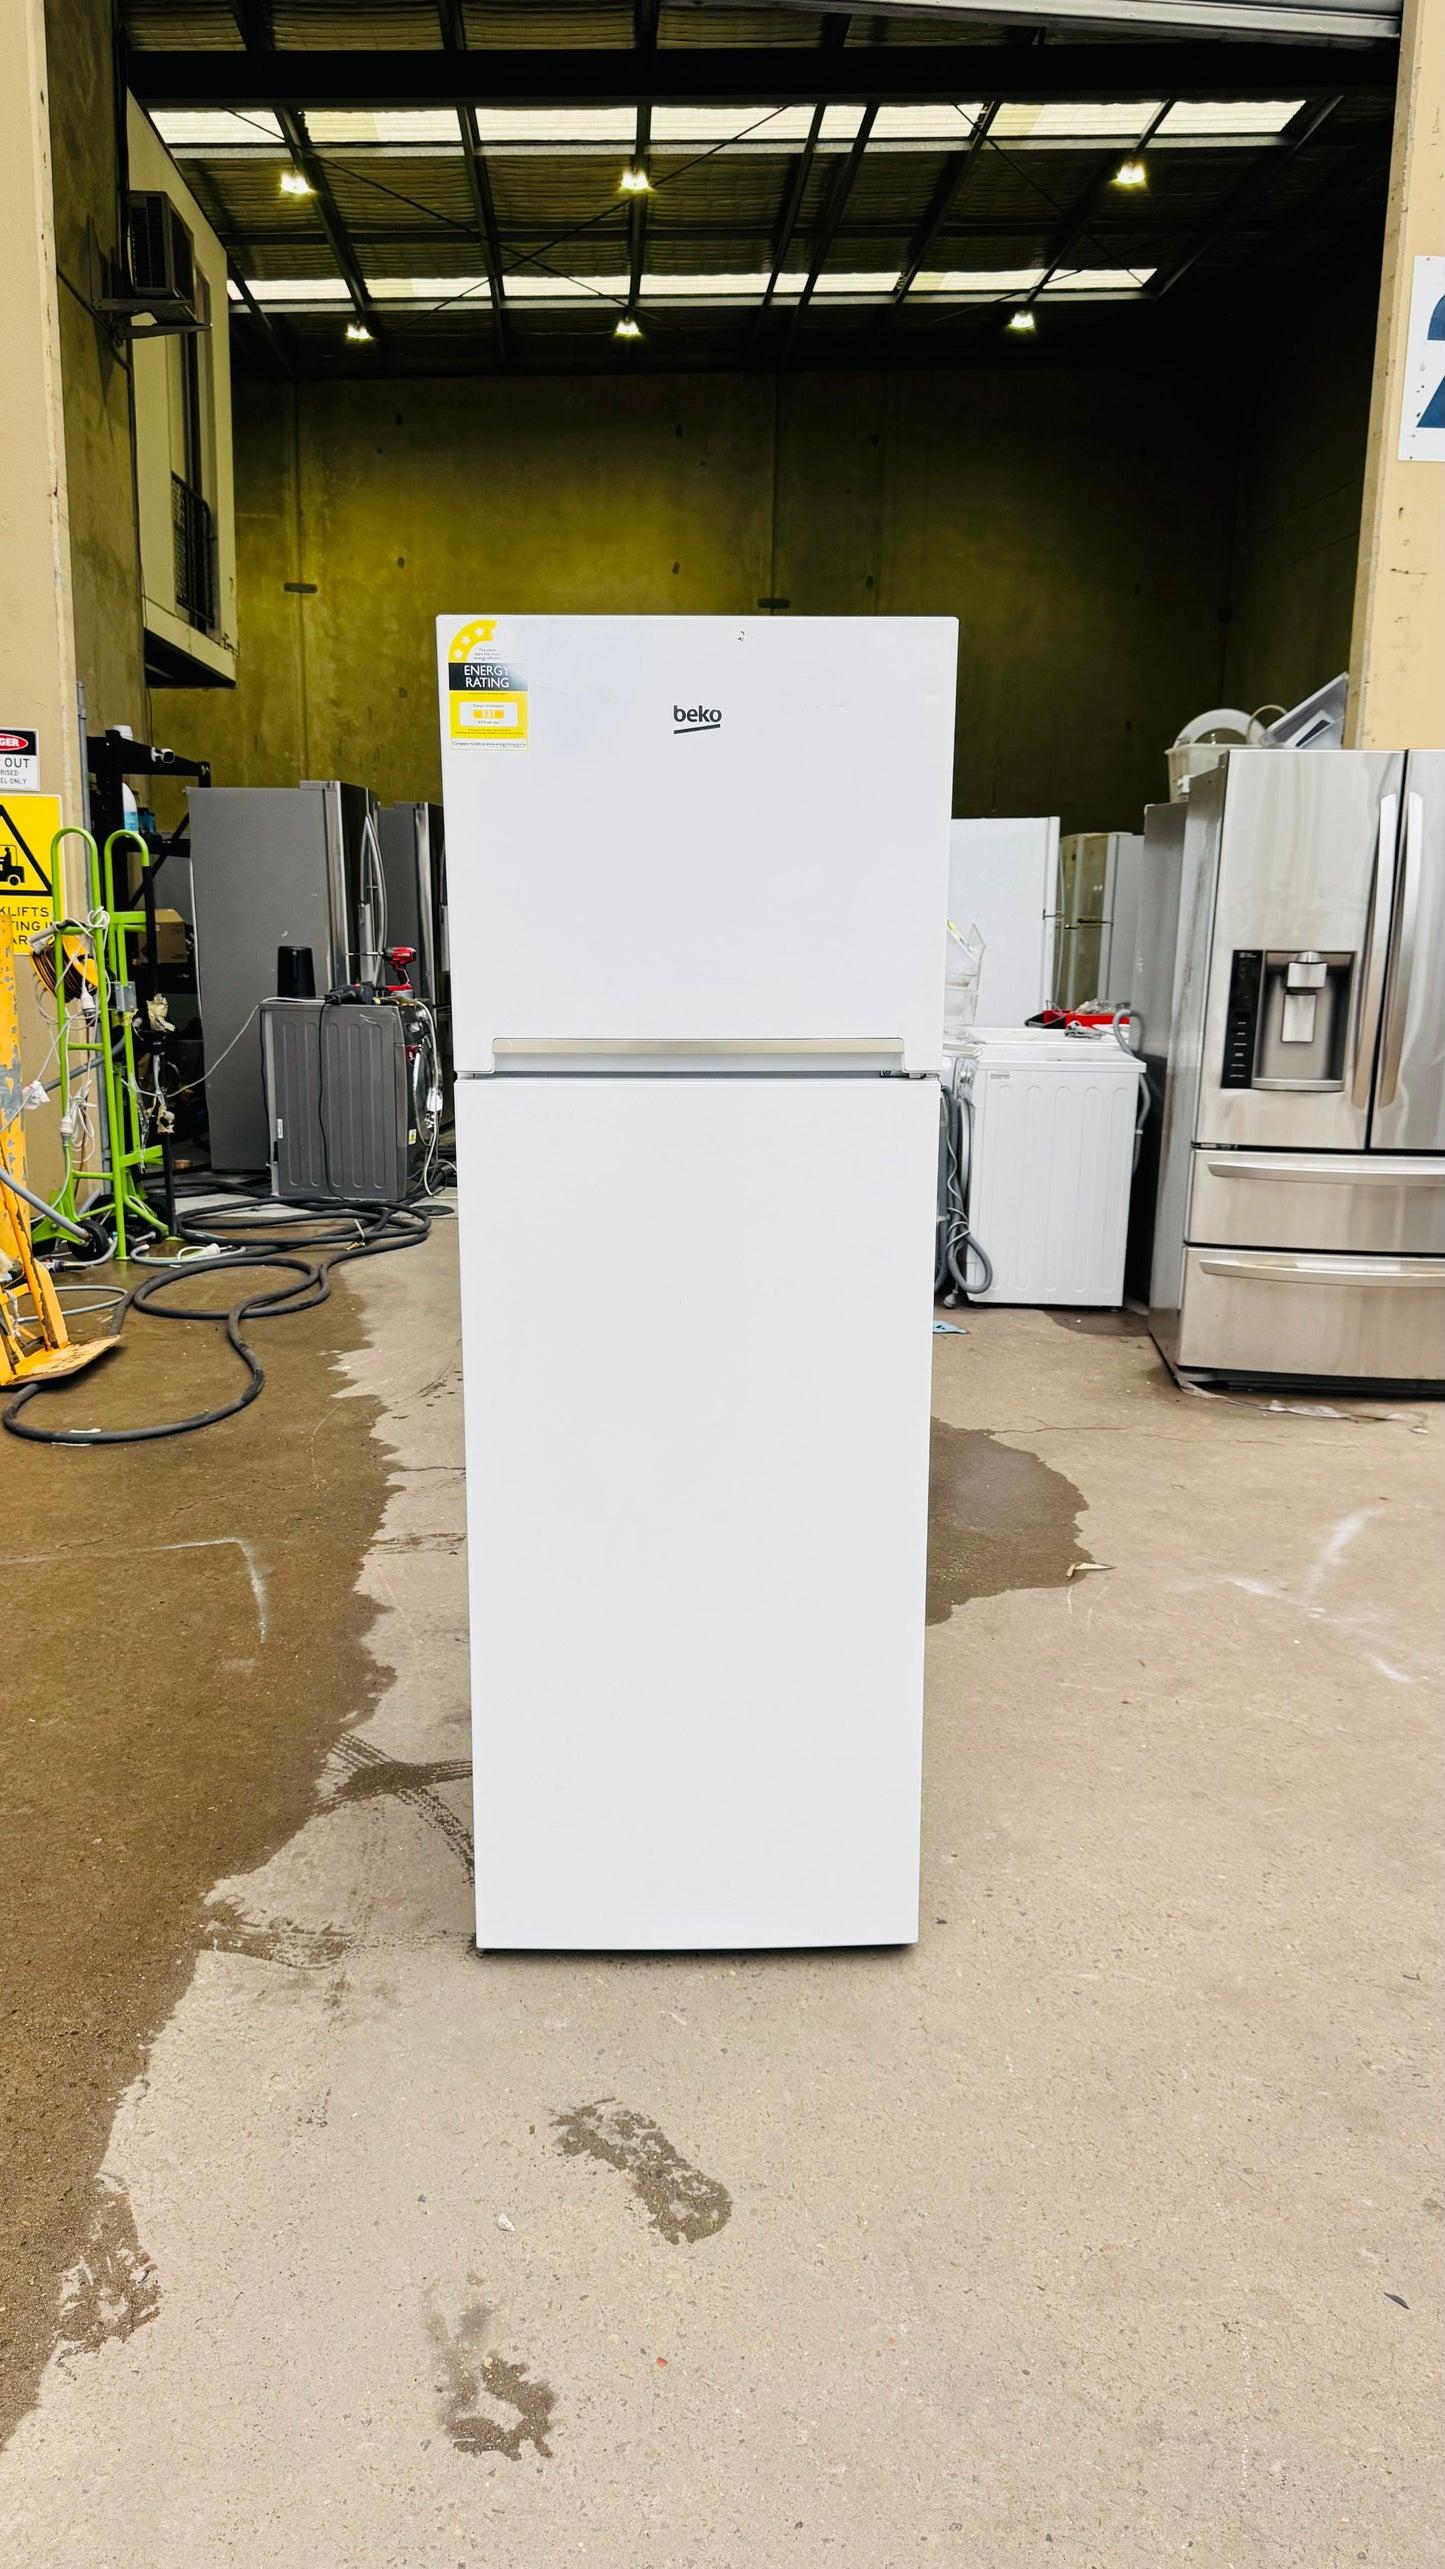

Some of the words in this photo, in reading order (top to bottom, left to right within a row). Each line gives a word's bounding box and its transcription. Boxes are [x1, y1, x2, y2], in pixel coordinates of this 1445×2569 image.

[464, 665, 510, 676] ENERGY
[465, 677, 510, 688] RATING
[673, 705, 722, 722] beko
[4, 757, 30, 768] OUT
